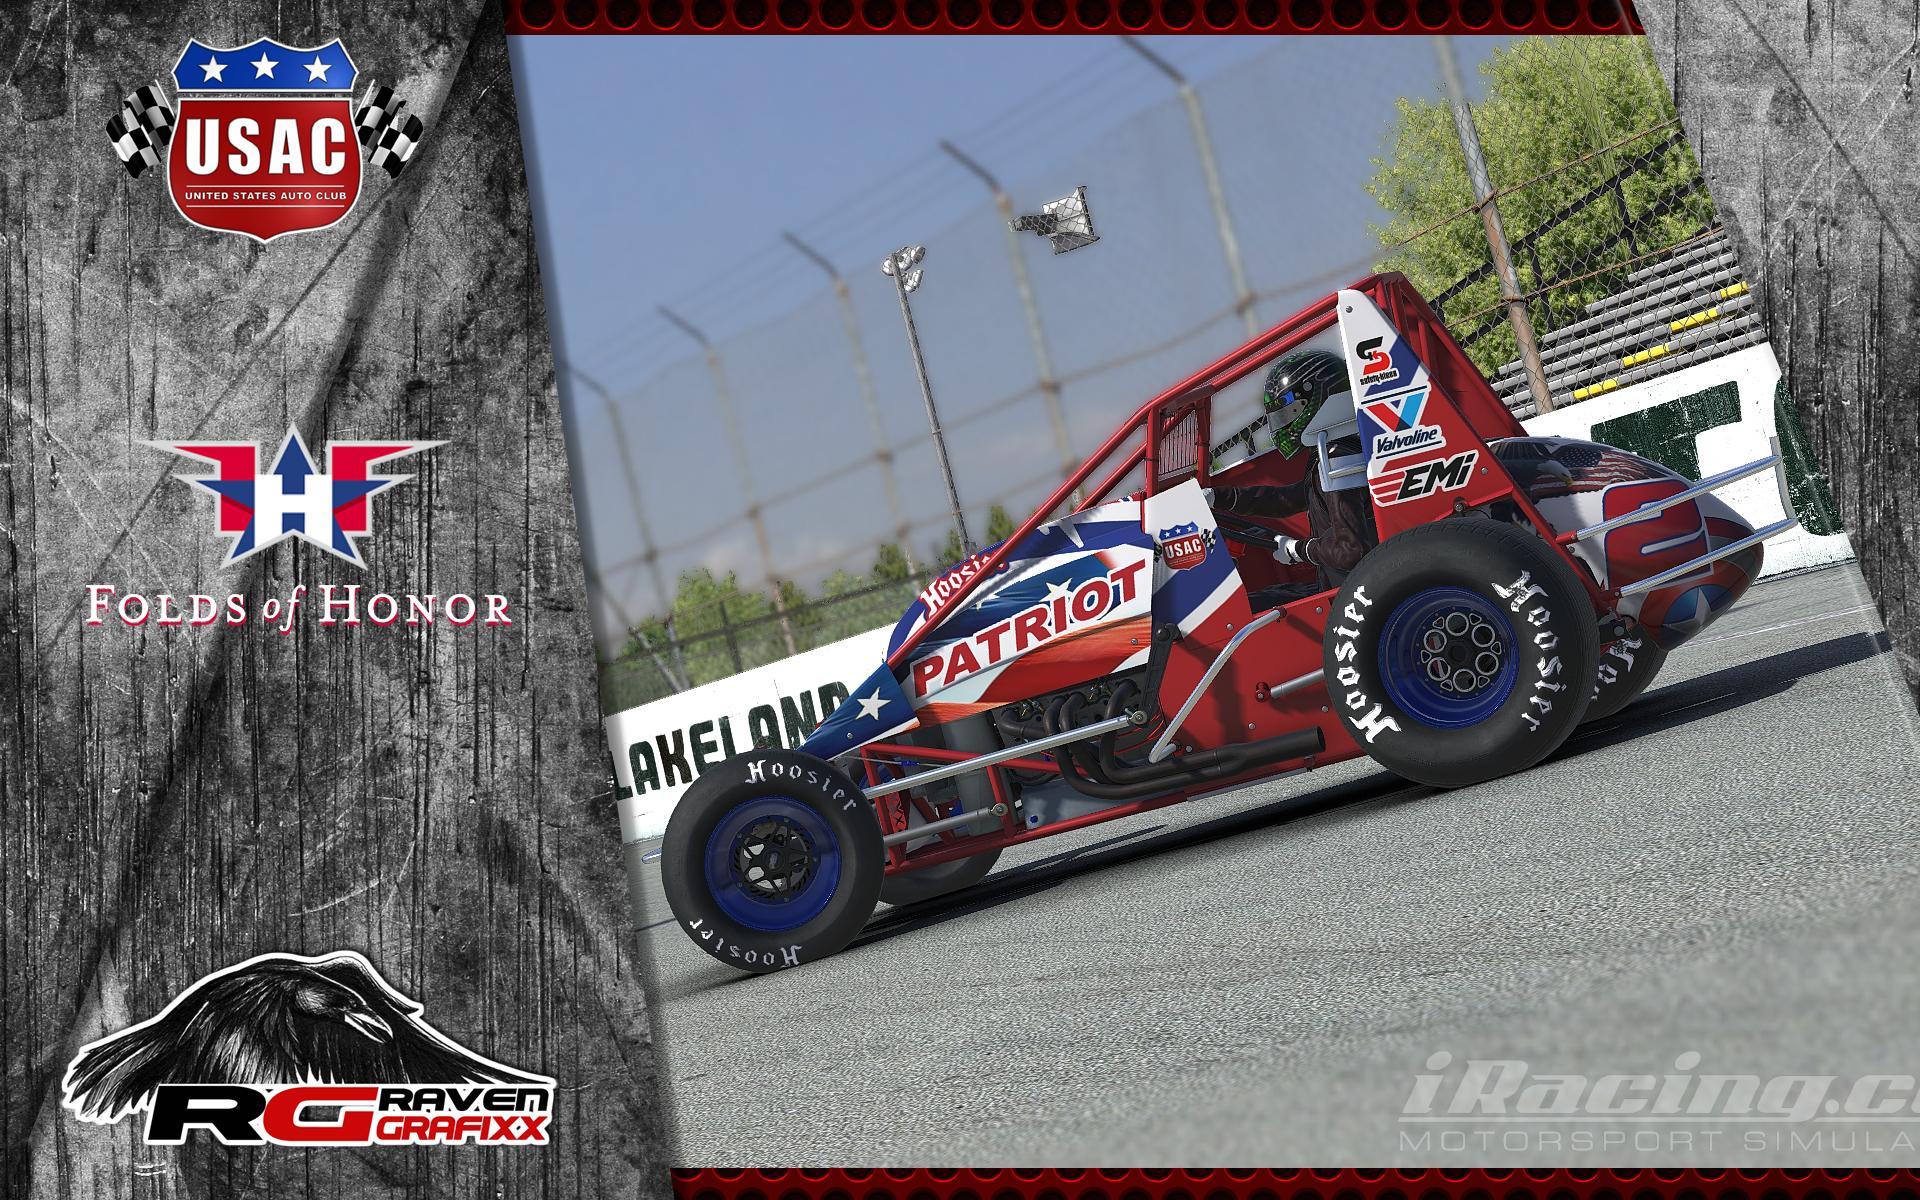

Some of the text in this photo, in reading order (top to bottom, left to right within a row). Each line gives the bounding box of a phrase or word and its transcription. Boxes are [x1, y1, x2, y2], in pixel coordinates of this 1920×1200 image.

[1375, 427, 1439, 454] Valvoline
[1164, 538, 1202, 559] USAC
[913, 559, 1146, 698] PATRIOT
[1490, 569, 1567, 732] Hoosier
[1333, 584, 1401, 744] Hoosier
[745, 759, 857, 811] Hoosier
[689, 918, 802, 969] Hoosier
